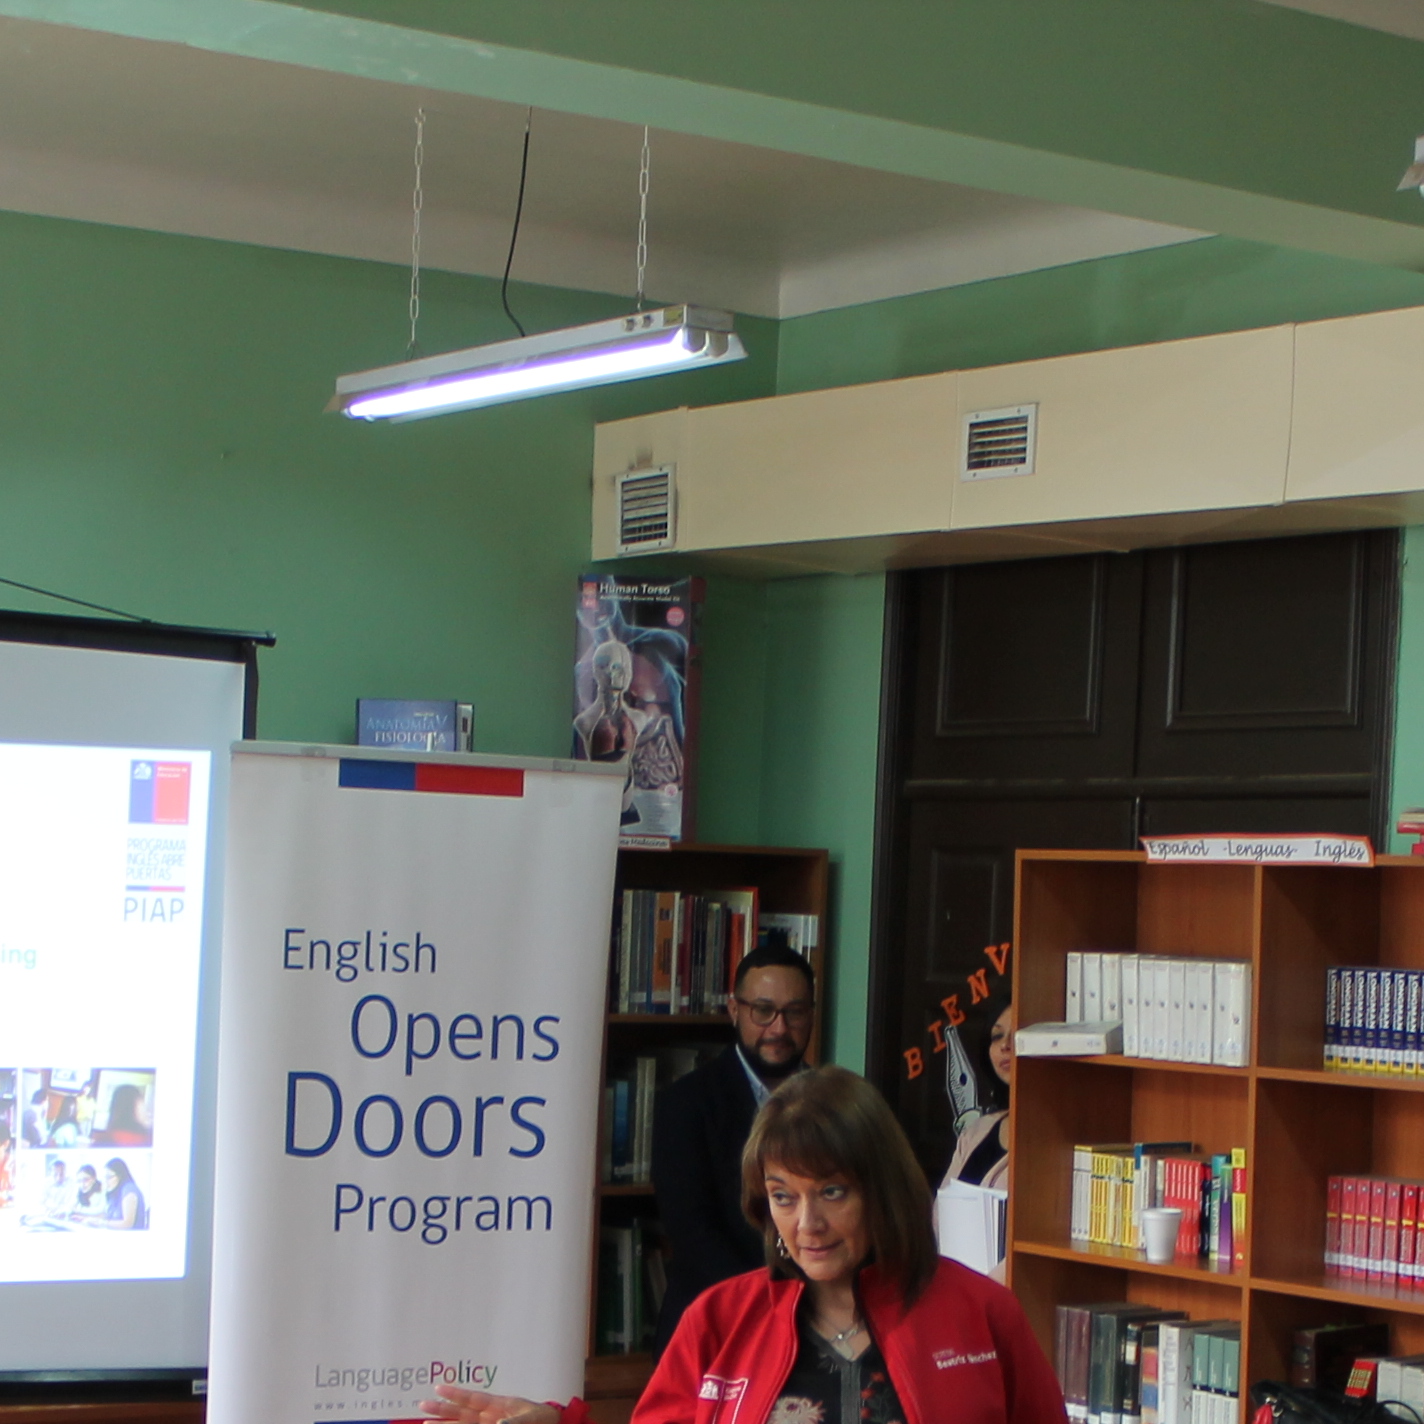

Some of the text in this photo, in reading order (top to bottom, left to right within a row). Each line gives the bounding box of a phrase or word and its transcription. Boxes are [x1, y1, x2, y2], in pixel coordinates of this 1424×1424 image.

[599, 582, 671, 595] Human Torso
[126, 837, 187, 852] PROGRAMA
[161, 854, 185, 867] ABRE
[1148, 840, 1210, 861] Español
[1314, 840, 1365, 863] Inglés
[126, 867, 172, 880] PUERTAS
[123, 896, 185, 923] PIAP
[283, 928, 437, 983] English
[1329, 969, 1338, 1025] LONGMAN
[1344, 971, 1352, 1028] LONGMAN
[1357, 970, 1365, 1027] LONGMAN
[1369, 972, 1377, 1029] LONGMAN
[1383, 972, 1391, 1029] LONGMAN
[1396, 973, 1405, 1031] LONGMAN
[1410, 974, 1419, 1033] LONGMAN
[350, 994, 561, 1076] Opens
[284, 1070, 547, 1158] Doors
[332, 1182, 553, 1245] Program
